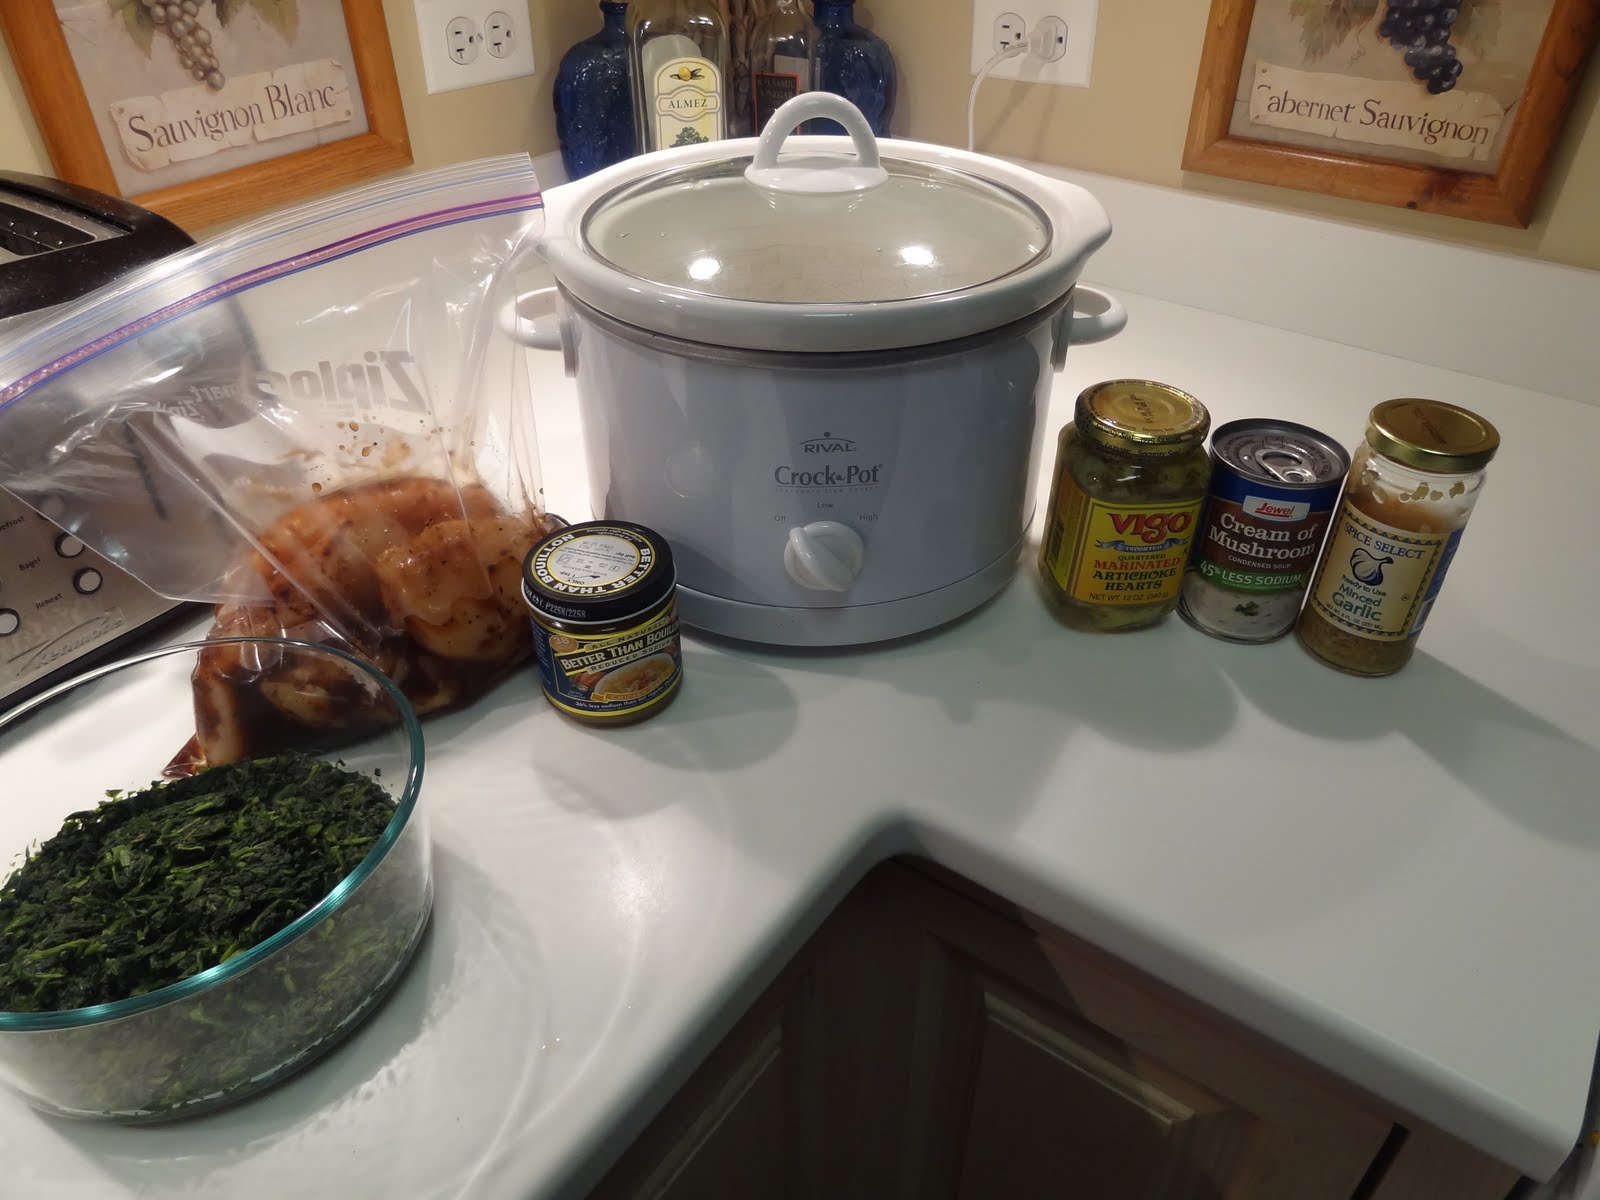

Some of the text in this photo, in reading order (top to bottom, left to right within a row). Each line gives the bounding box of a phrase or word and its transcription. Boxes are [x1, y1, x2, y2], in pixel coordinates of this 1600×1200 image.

[668, 98, 708, 109] ALMEZ
[128, 83, 337, 152] Sauvignon Blanc
[1257, 84, 1489, 145] abernet Sauvignon
[804, 442, 853, 454] RIVAL
[859, 513, 879, 522] High
[1256, 502, 1295, 517] Jewel
[1220, 513, 1318, 542] Cream of
[1208, 524, 1315, 560] Mushroom
[1344, 522, 1425, 560] SPICE SELECT
[18, 557, 42, 572] Bagel
[535, 533, 575, 583] BOUILLON
[1093, 557, 1181, 571] MARINATED
[1117, 553, 1166, 561] QUARTERED
[1227, 555, 1272, 569] CONDENSED
[612, 548, 652, 589] BETTER
[1092, 567, 1177, 581] ARTICHOKE
[1200, 560, 1221, 577] 45%
[1222, 570, 1253, 585] LESS
[1254, 573, 1302, 586] SODIUM
[554, 582, 607, 594] THAN
[1104, 580, 1163, 591] HEARTS
[1341, 573, 1387, 597] Ready to Use
[35, 592, 64, 611] Reheat
[1089, 592, 1106, 601] NET
[1338, 583, 1383, 607] Minced
[545, 602, 587, 618] P2258/2258
[1332, 591, 1382, 622] Garlic
[553, 635, 569, 646] 38
[560, 651, 607, 670] BETTER
[607, 639, 644, 658] THAN
[590, 653, 639, 671] REDUCED
